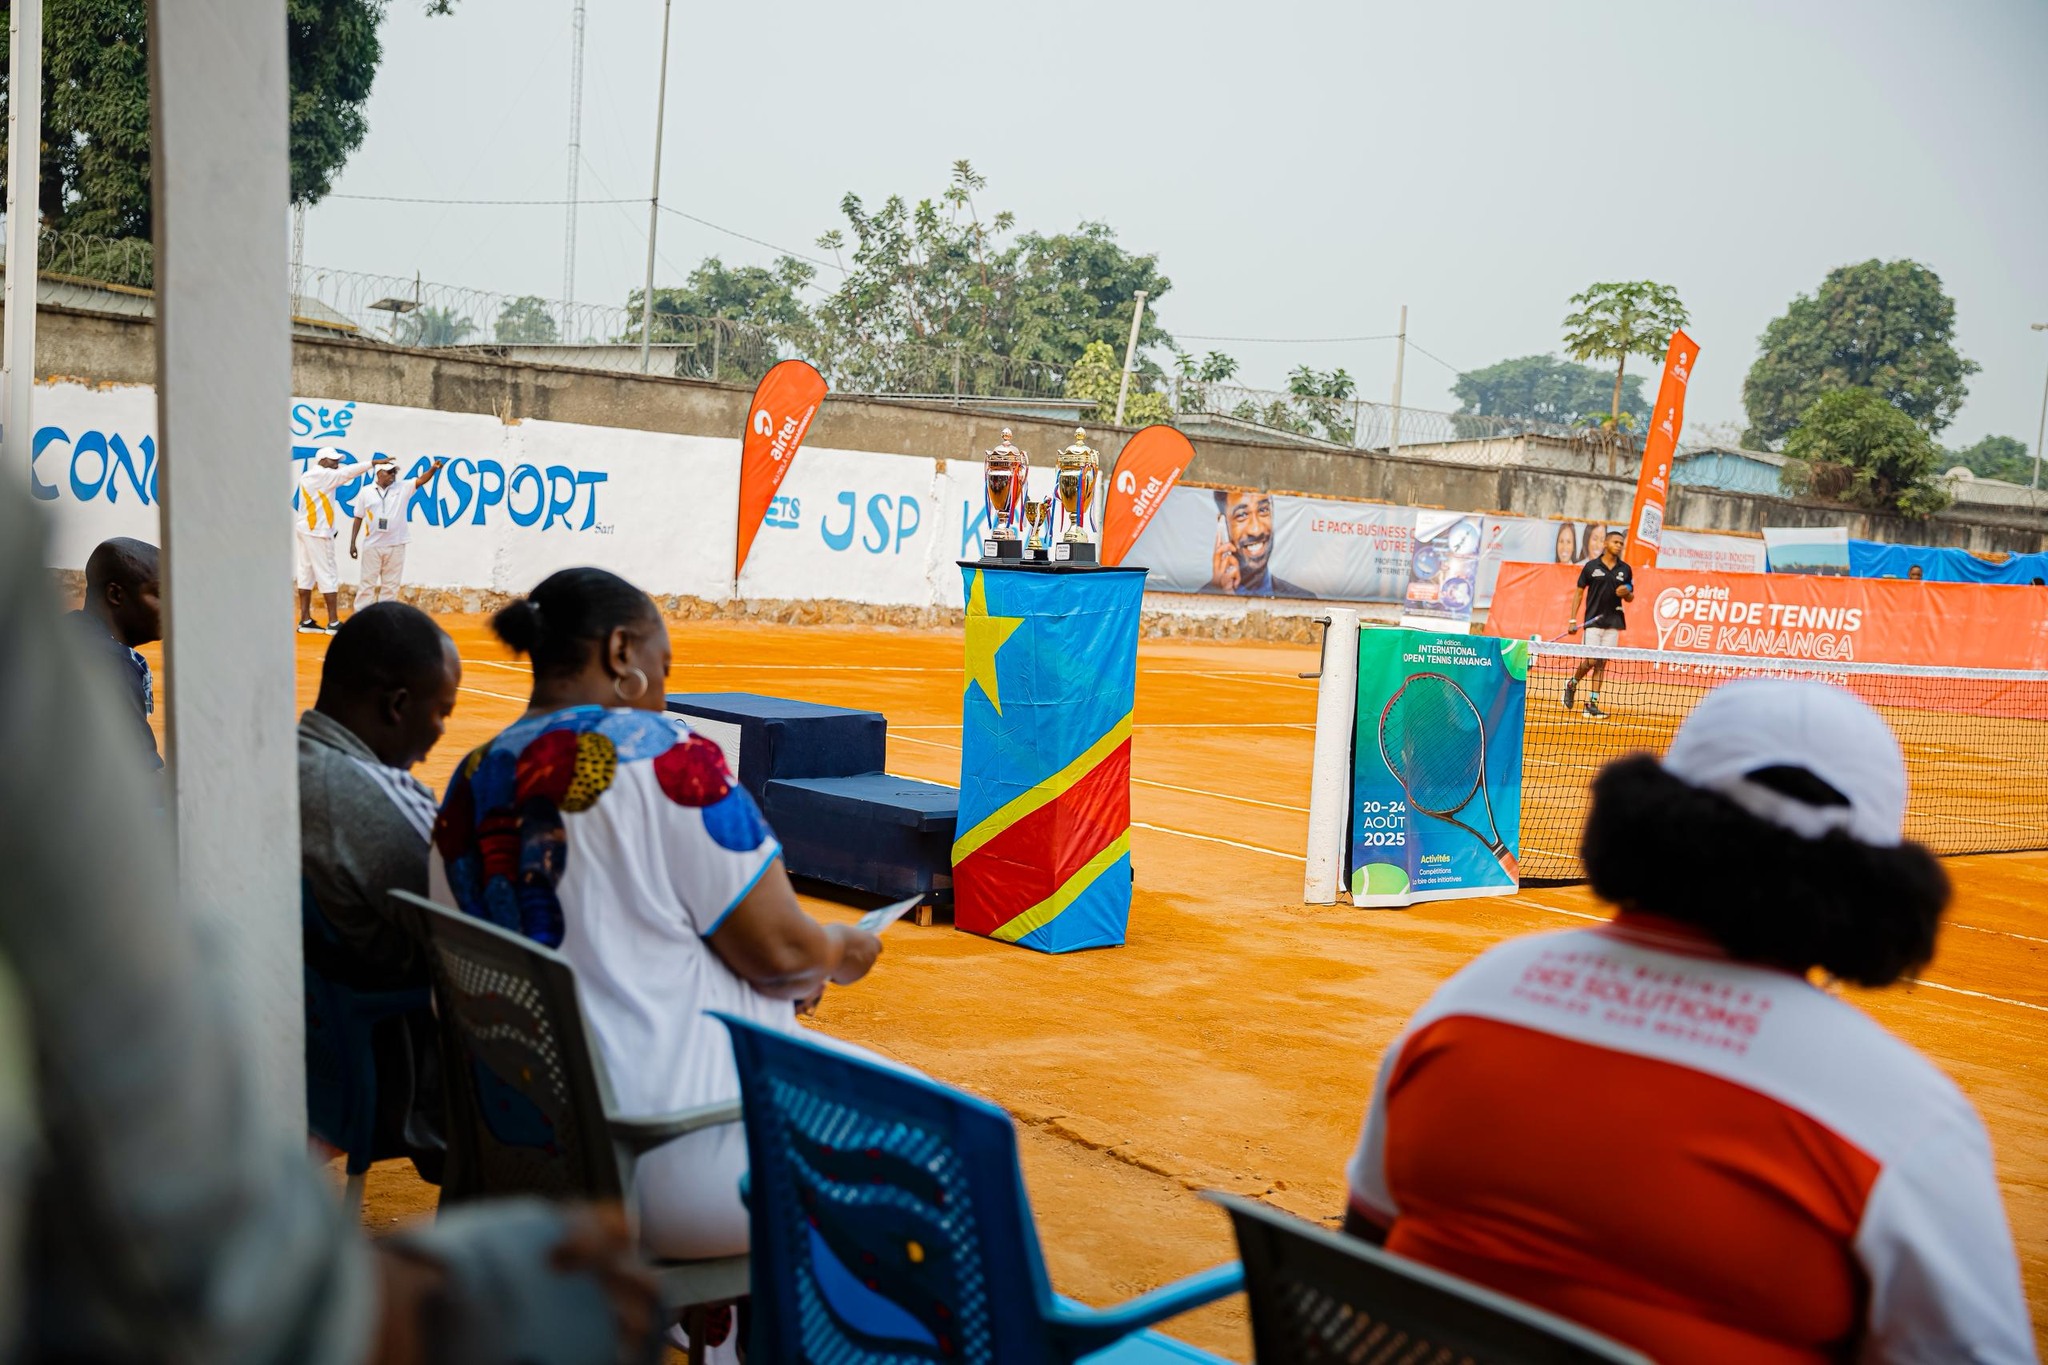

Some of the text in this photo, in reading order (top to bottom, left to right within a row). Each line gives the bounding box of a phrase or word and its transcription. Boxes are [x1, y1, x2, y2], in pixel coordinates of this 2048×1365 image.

[770, 415, 799, 461] airtel
[31, 426, 159, 506] CON
[1132, 475, 1163, 517] airtel
[821, 491, 920, 554] JSP
[1311, 519, 1324, 532] LE
[1327, 521, 1354, 534] PACK
[1357, 523, 1407, 539] BUSINESS
[1374, 540, 1407, 553] VOTRE
[1696, 585, 1730, 601] airtel
[1729, 600, 1764, 625] DE
[1768, 603, 1863, 632] TENNIS
[1418, 644, 1477, 656] INTERNATIONAL
[1674, 622, 1855, 661] DE KANANGA
[1403, 653, 1492, 667] OPEN TENNIS KANANGA
[1363, 814, 1406, 829] AOÛT
[1364, 832, 1406, 846] 2025
[1420, 853, 1451, 864] Activités
